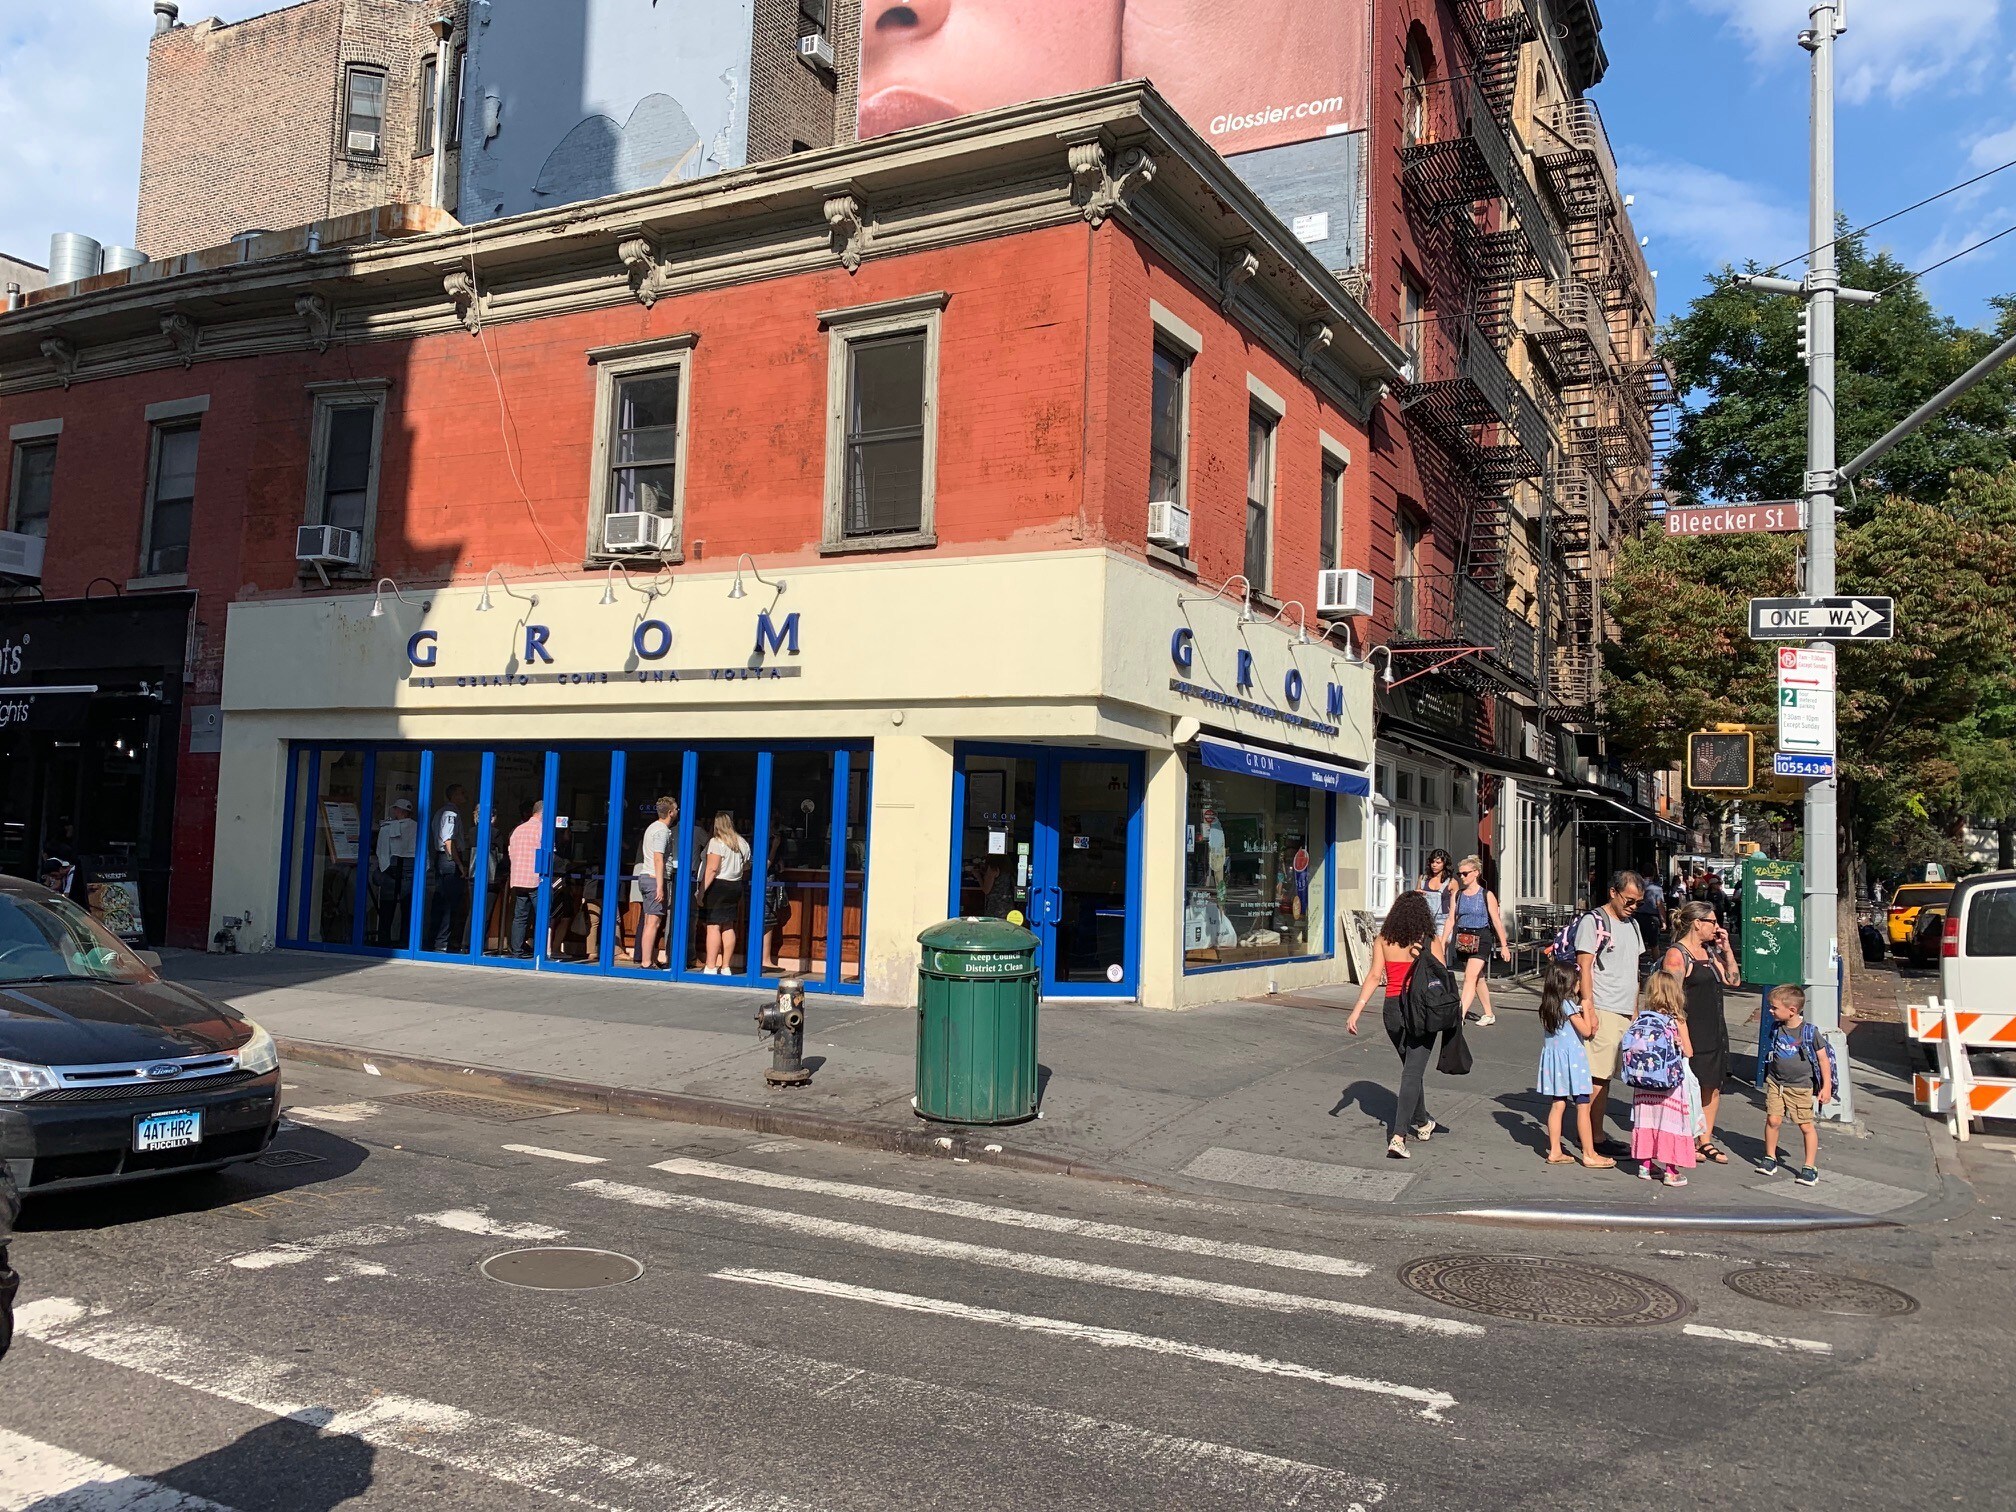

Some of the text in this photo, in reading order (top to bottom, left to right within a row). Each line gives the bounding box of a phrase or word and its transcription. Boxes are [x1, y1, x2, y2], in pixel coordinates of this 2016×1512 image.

[1209, 96, 1343, 135] Glossier.com
[1670, 508, 1784, 533] Bleecker St
[1770, 610, 1870, 626] ONE WAY
[407, 612, 801, 668] GROM
[420, 678, 435, 688] IL
[638, 670, 680, 683] UNA
[710, 667, 781, 681] VOLTA
[1171, 628, 1343, 716] GROM
[1784, 689, 1794, 706] 2
[1783, 721, 1820, 731] Except Sunday
[1245, 753, 1275, 771] GROM
[983, 812, 1016, 821] GROM
[970, 953, 991, 962] Keep
[965, 963, 1024, 972] District 2 Clean
[149, 1138, 188, 1151] FUCCILLO
